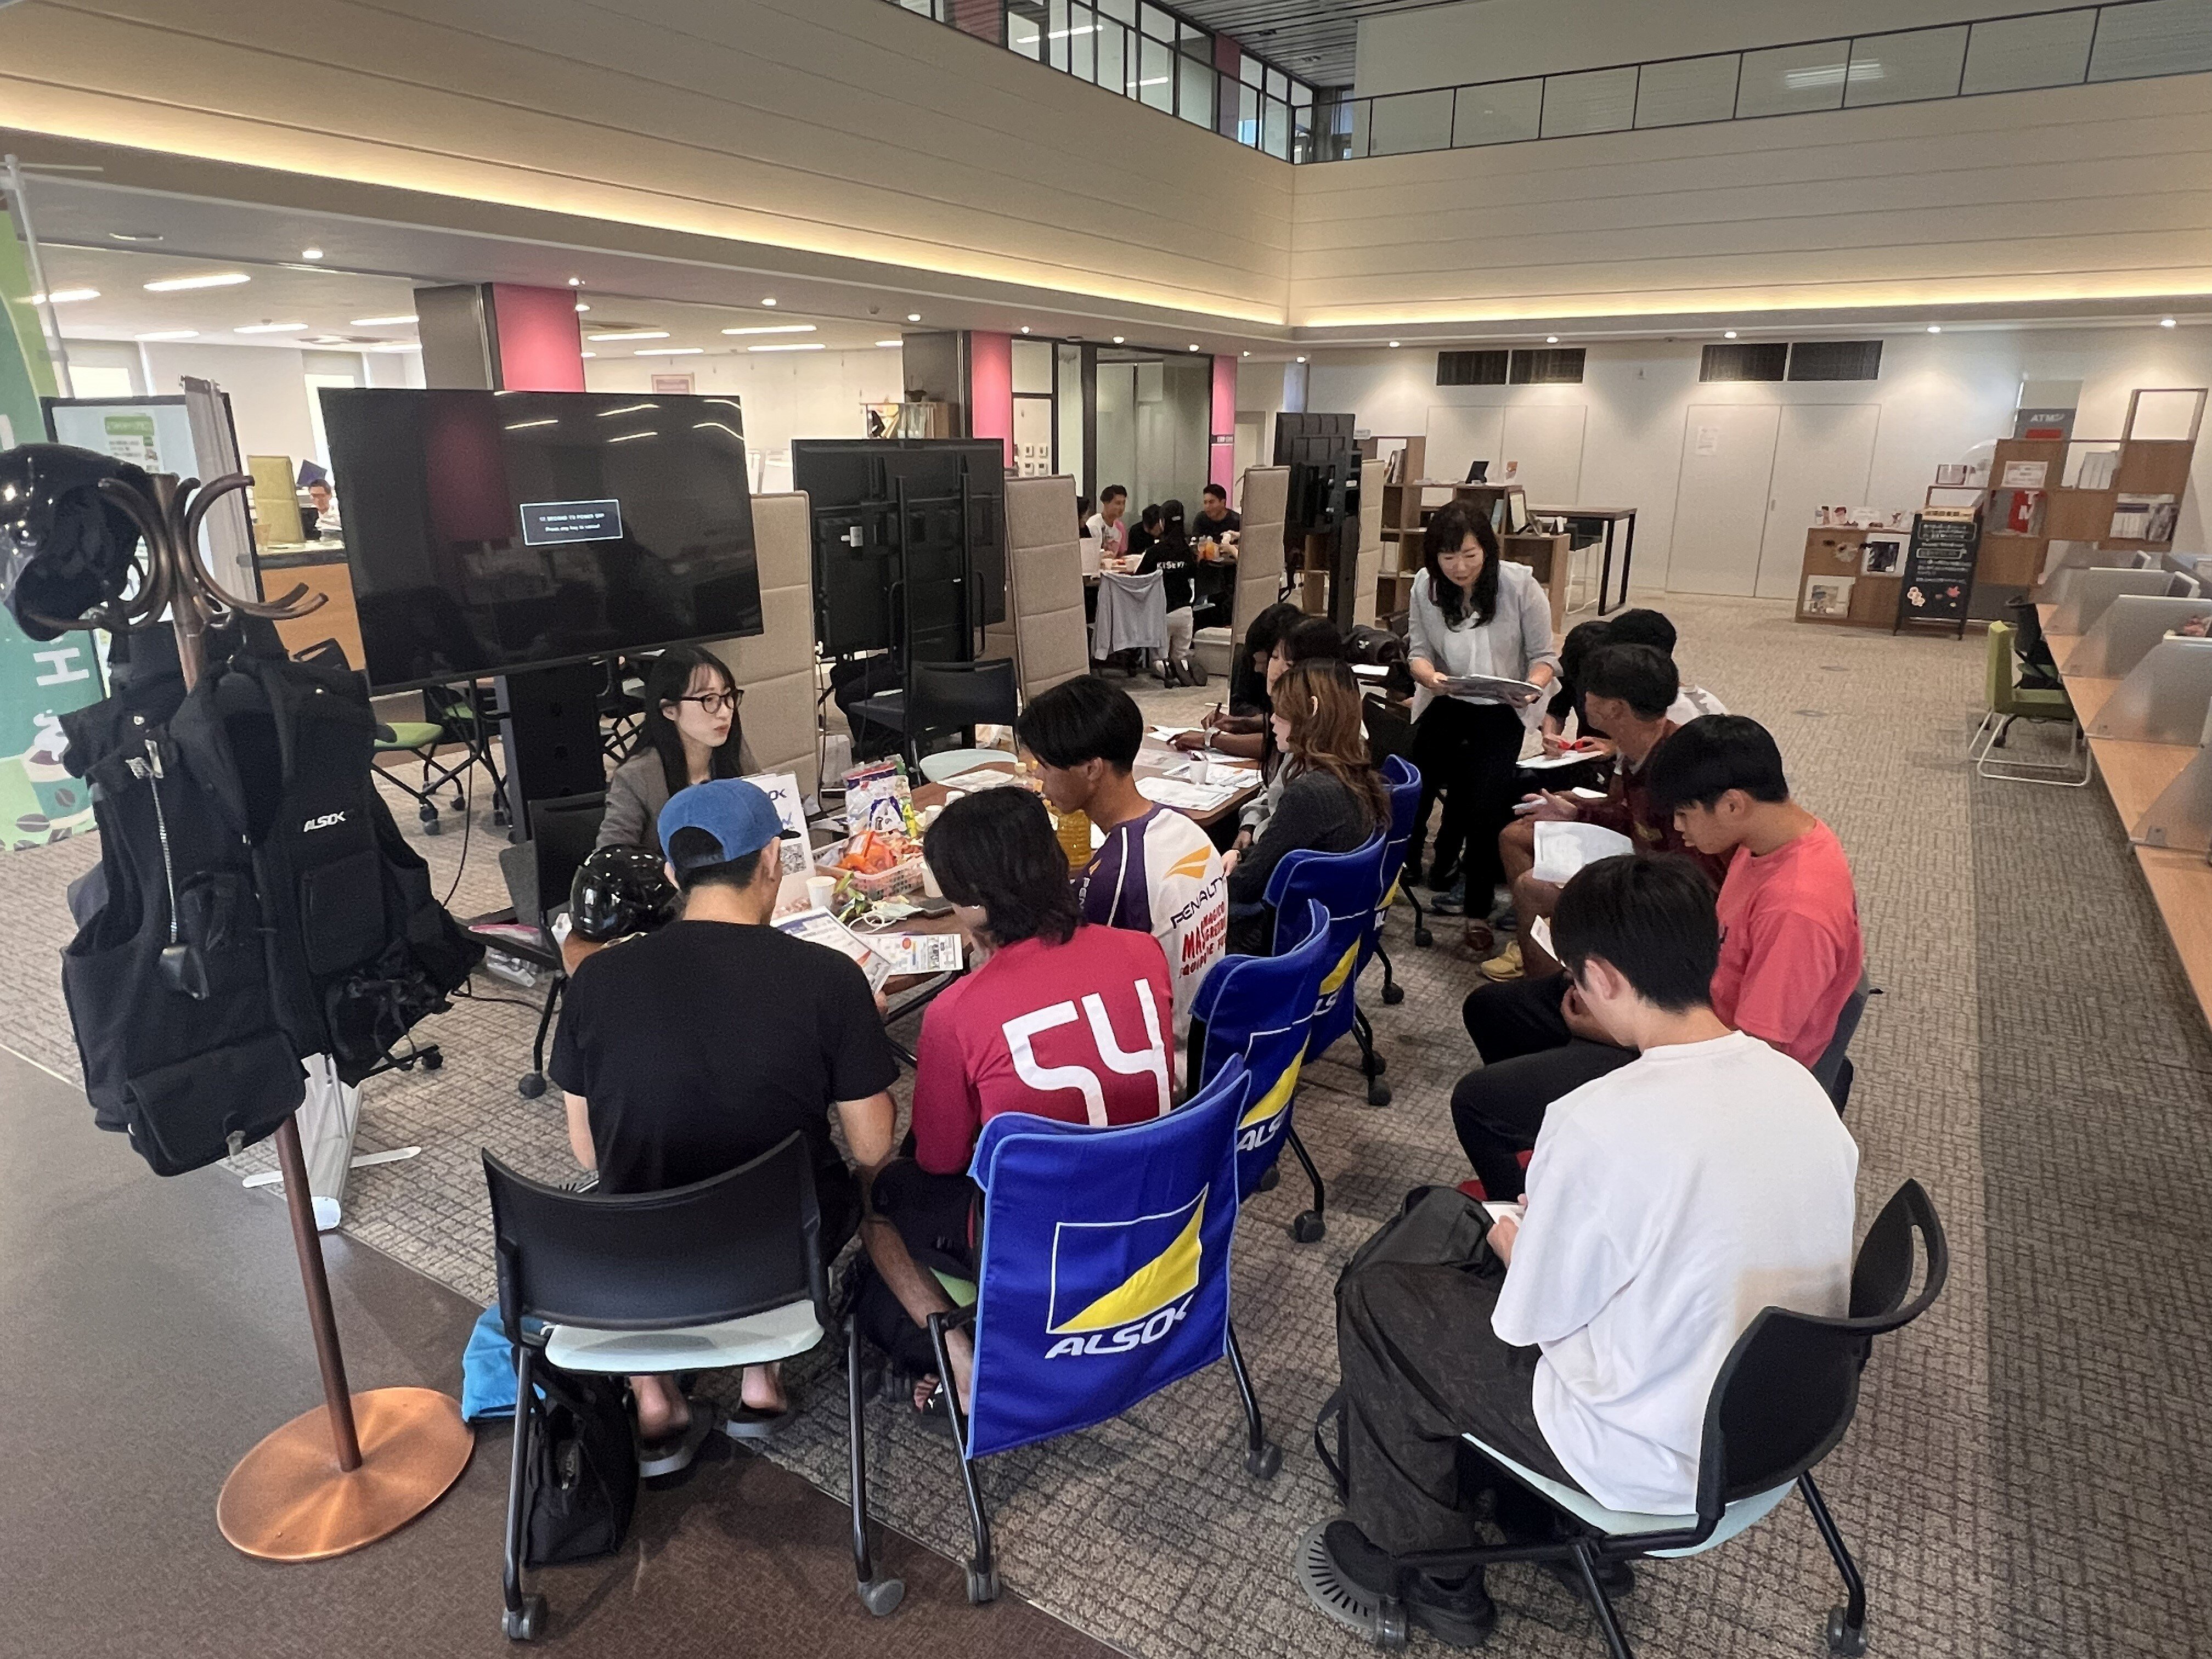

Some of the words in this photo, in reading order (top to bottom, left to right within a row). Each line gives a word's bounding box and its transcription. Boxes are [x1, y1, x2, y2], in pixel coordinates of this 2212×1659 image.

[303, 811, 347, 832] ALSOK
[1002, 978, 1171, 1127] 54
[1044, 1293, 1194, 1359] ALSOK
